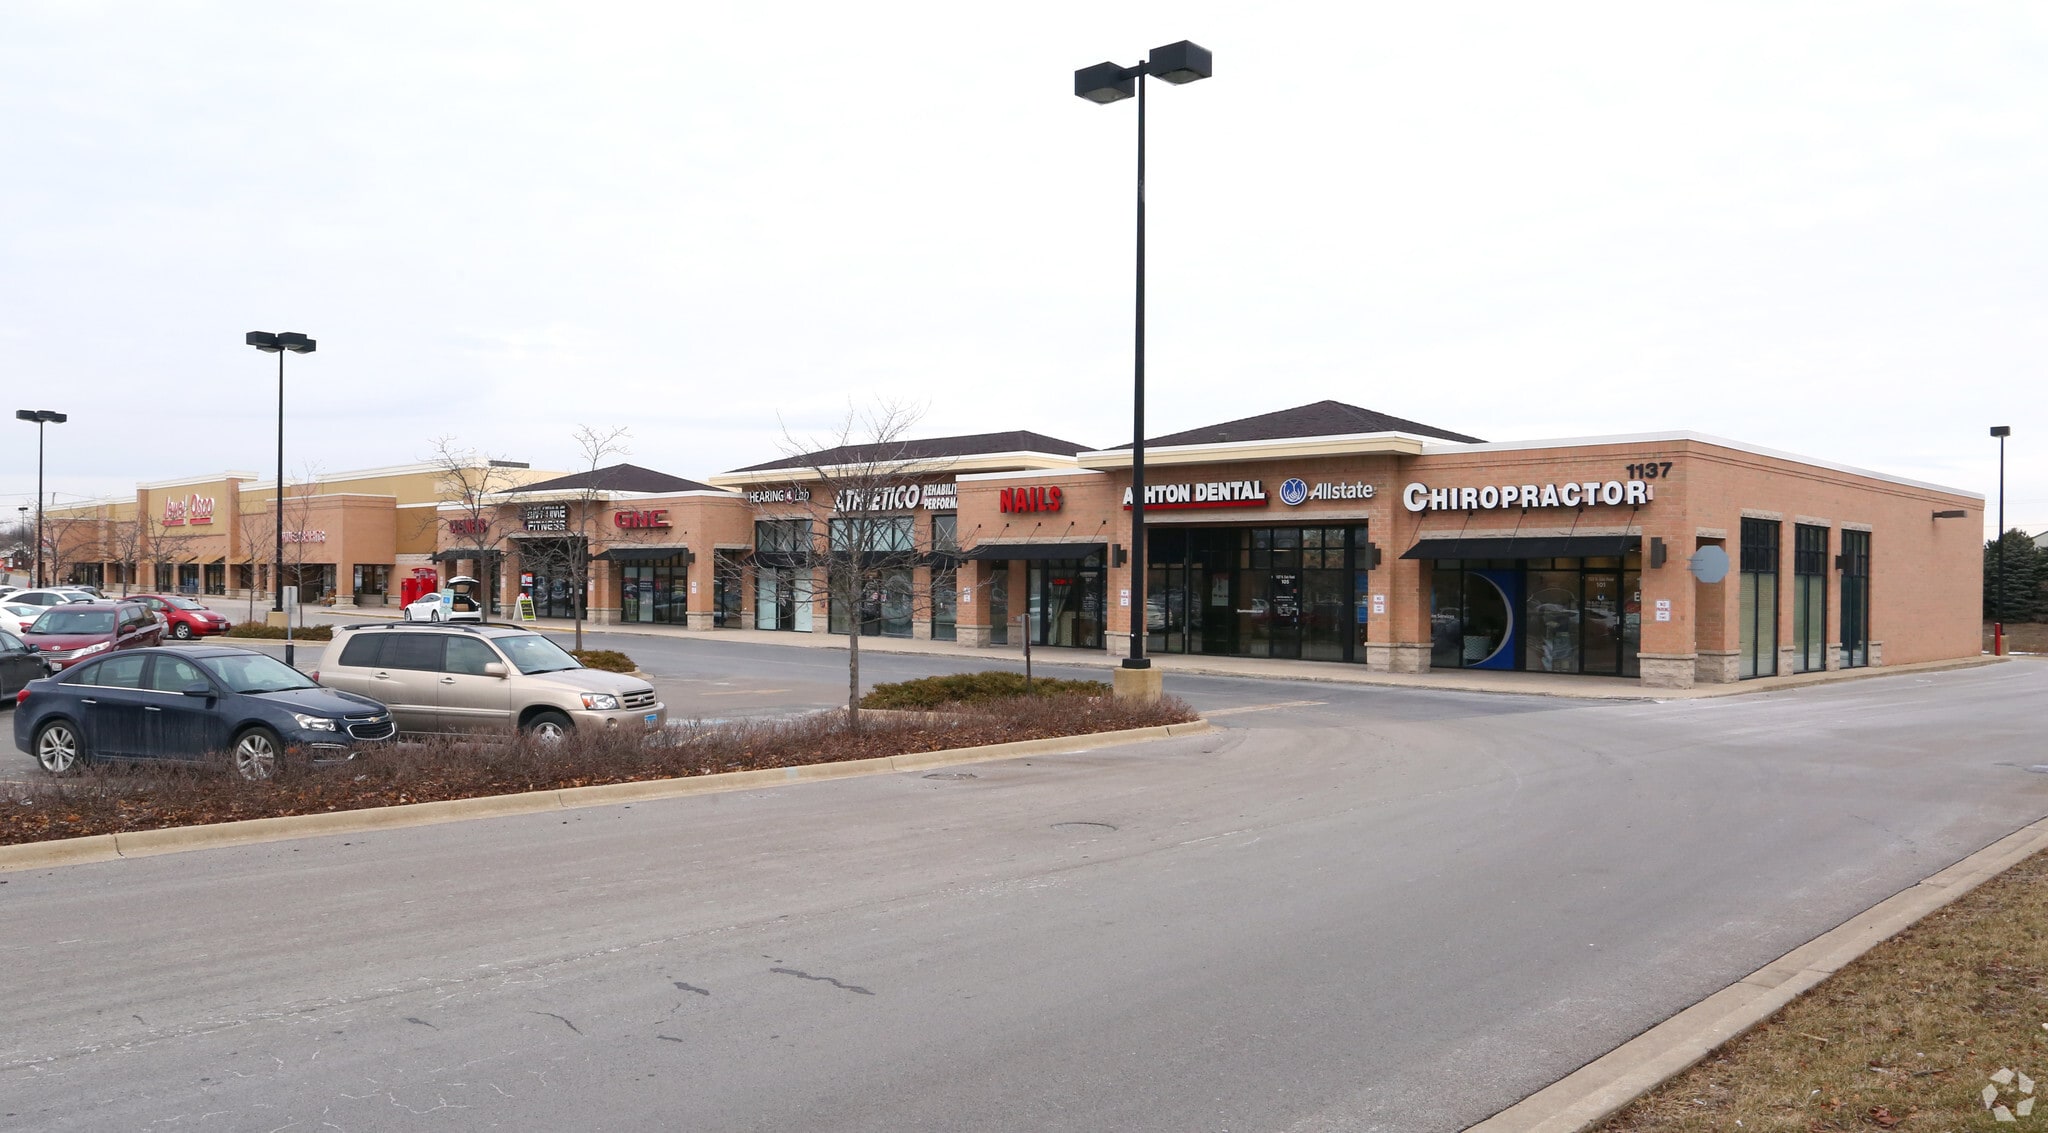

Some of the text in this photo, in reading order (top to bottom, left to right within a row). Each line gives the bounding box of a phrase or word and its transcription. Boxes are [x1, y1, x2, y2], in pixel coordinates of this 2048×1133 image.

[1626, 462, 1673, 480] 1137
[749, 489, 784, 503] HEARING
[794, 488, 810, 501] Lab
[1000, 485, 1062, 513] NAILS
[1122, 480, 1265, 504] AHTON DENTAL
[1310, 481, 1374, 500] Allstate
[1403, 480, 1649, 512] CHIROPRACTOR
[191, 494, 215, 516] Osco
[527, 519, 566, 532] FITNESS
[614, 509, 670, 529] GNC
